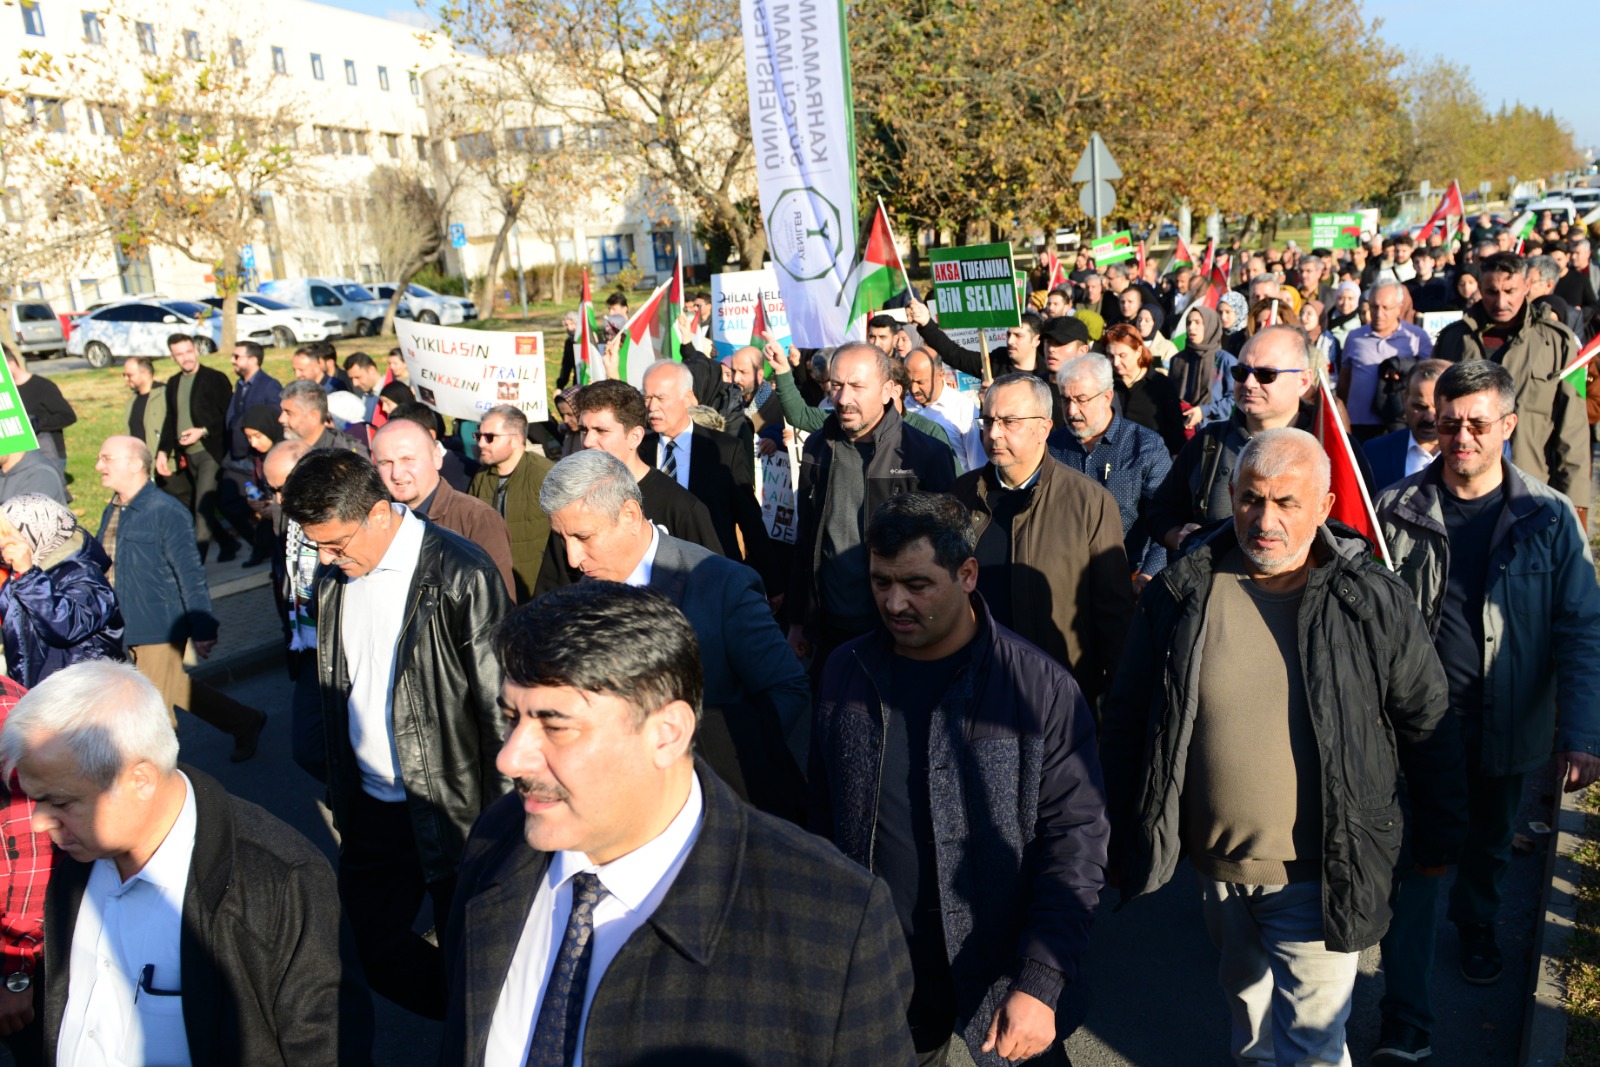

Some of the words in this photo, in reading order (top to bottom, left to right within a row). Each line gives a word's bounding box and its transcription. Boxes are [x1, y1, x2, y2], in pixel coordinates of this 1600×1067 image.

[934, 262, 960, 282] AKSA
[962, 258, 1011, 279] TUFANINA
[965, 284, 1015, 312] SELAM
[718, 305, 749, 317] SİYON
[411, 335, 490, 359] YIKILASIN
[421, 368, 480, 392] ENKAZINI
